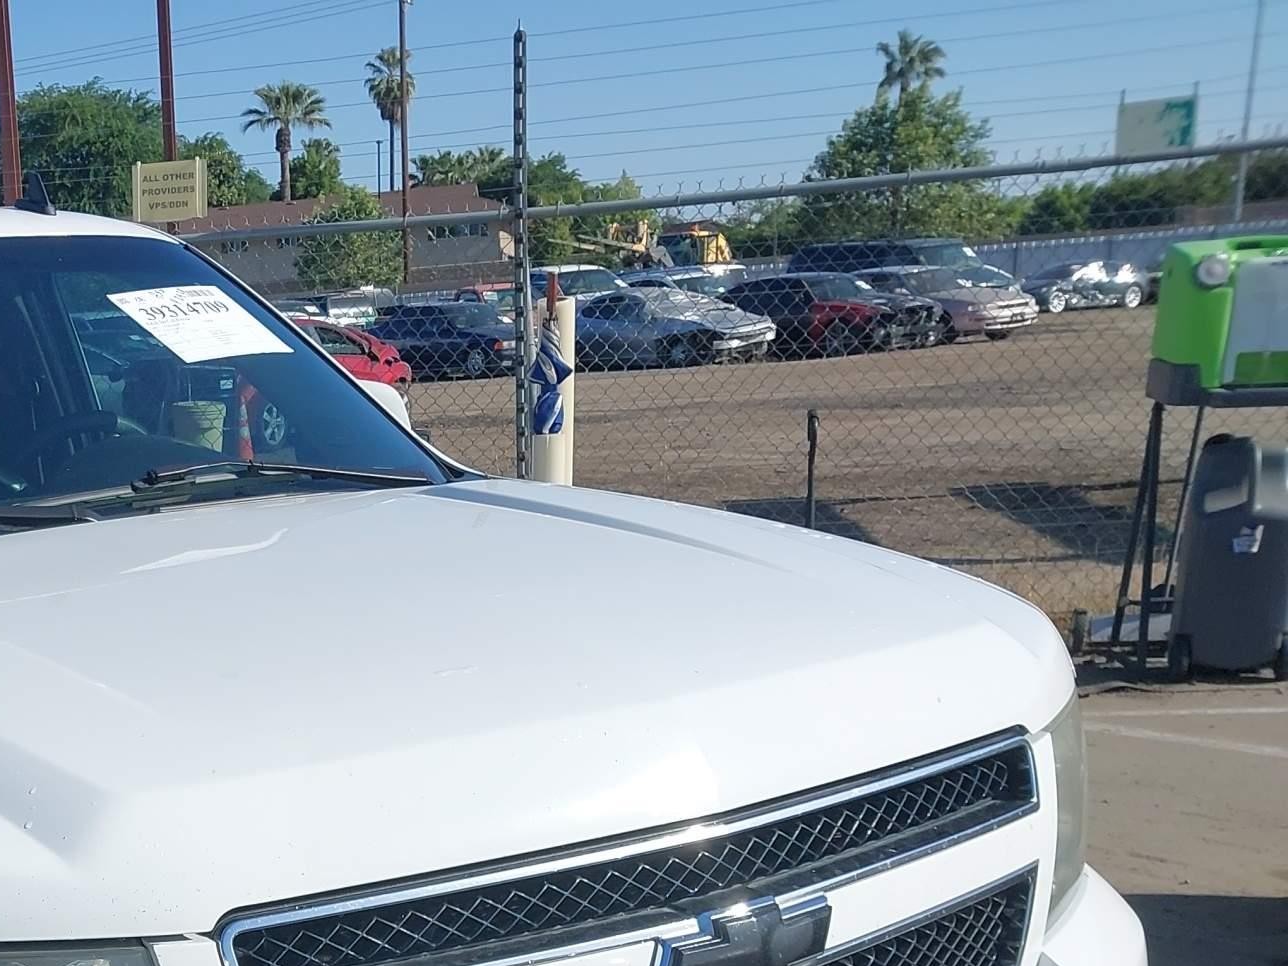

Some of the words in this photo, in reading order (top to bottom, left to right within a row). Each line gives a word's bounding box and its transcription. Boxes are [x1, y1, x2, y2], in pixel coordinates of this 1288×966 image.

[162, 172, 194, 181] OTHER
[142, 185, 195, 197] PROVIDERS
[138, 300, 230, 322] 39314709
